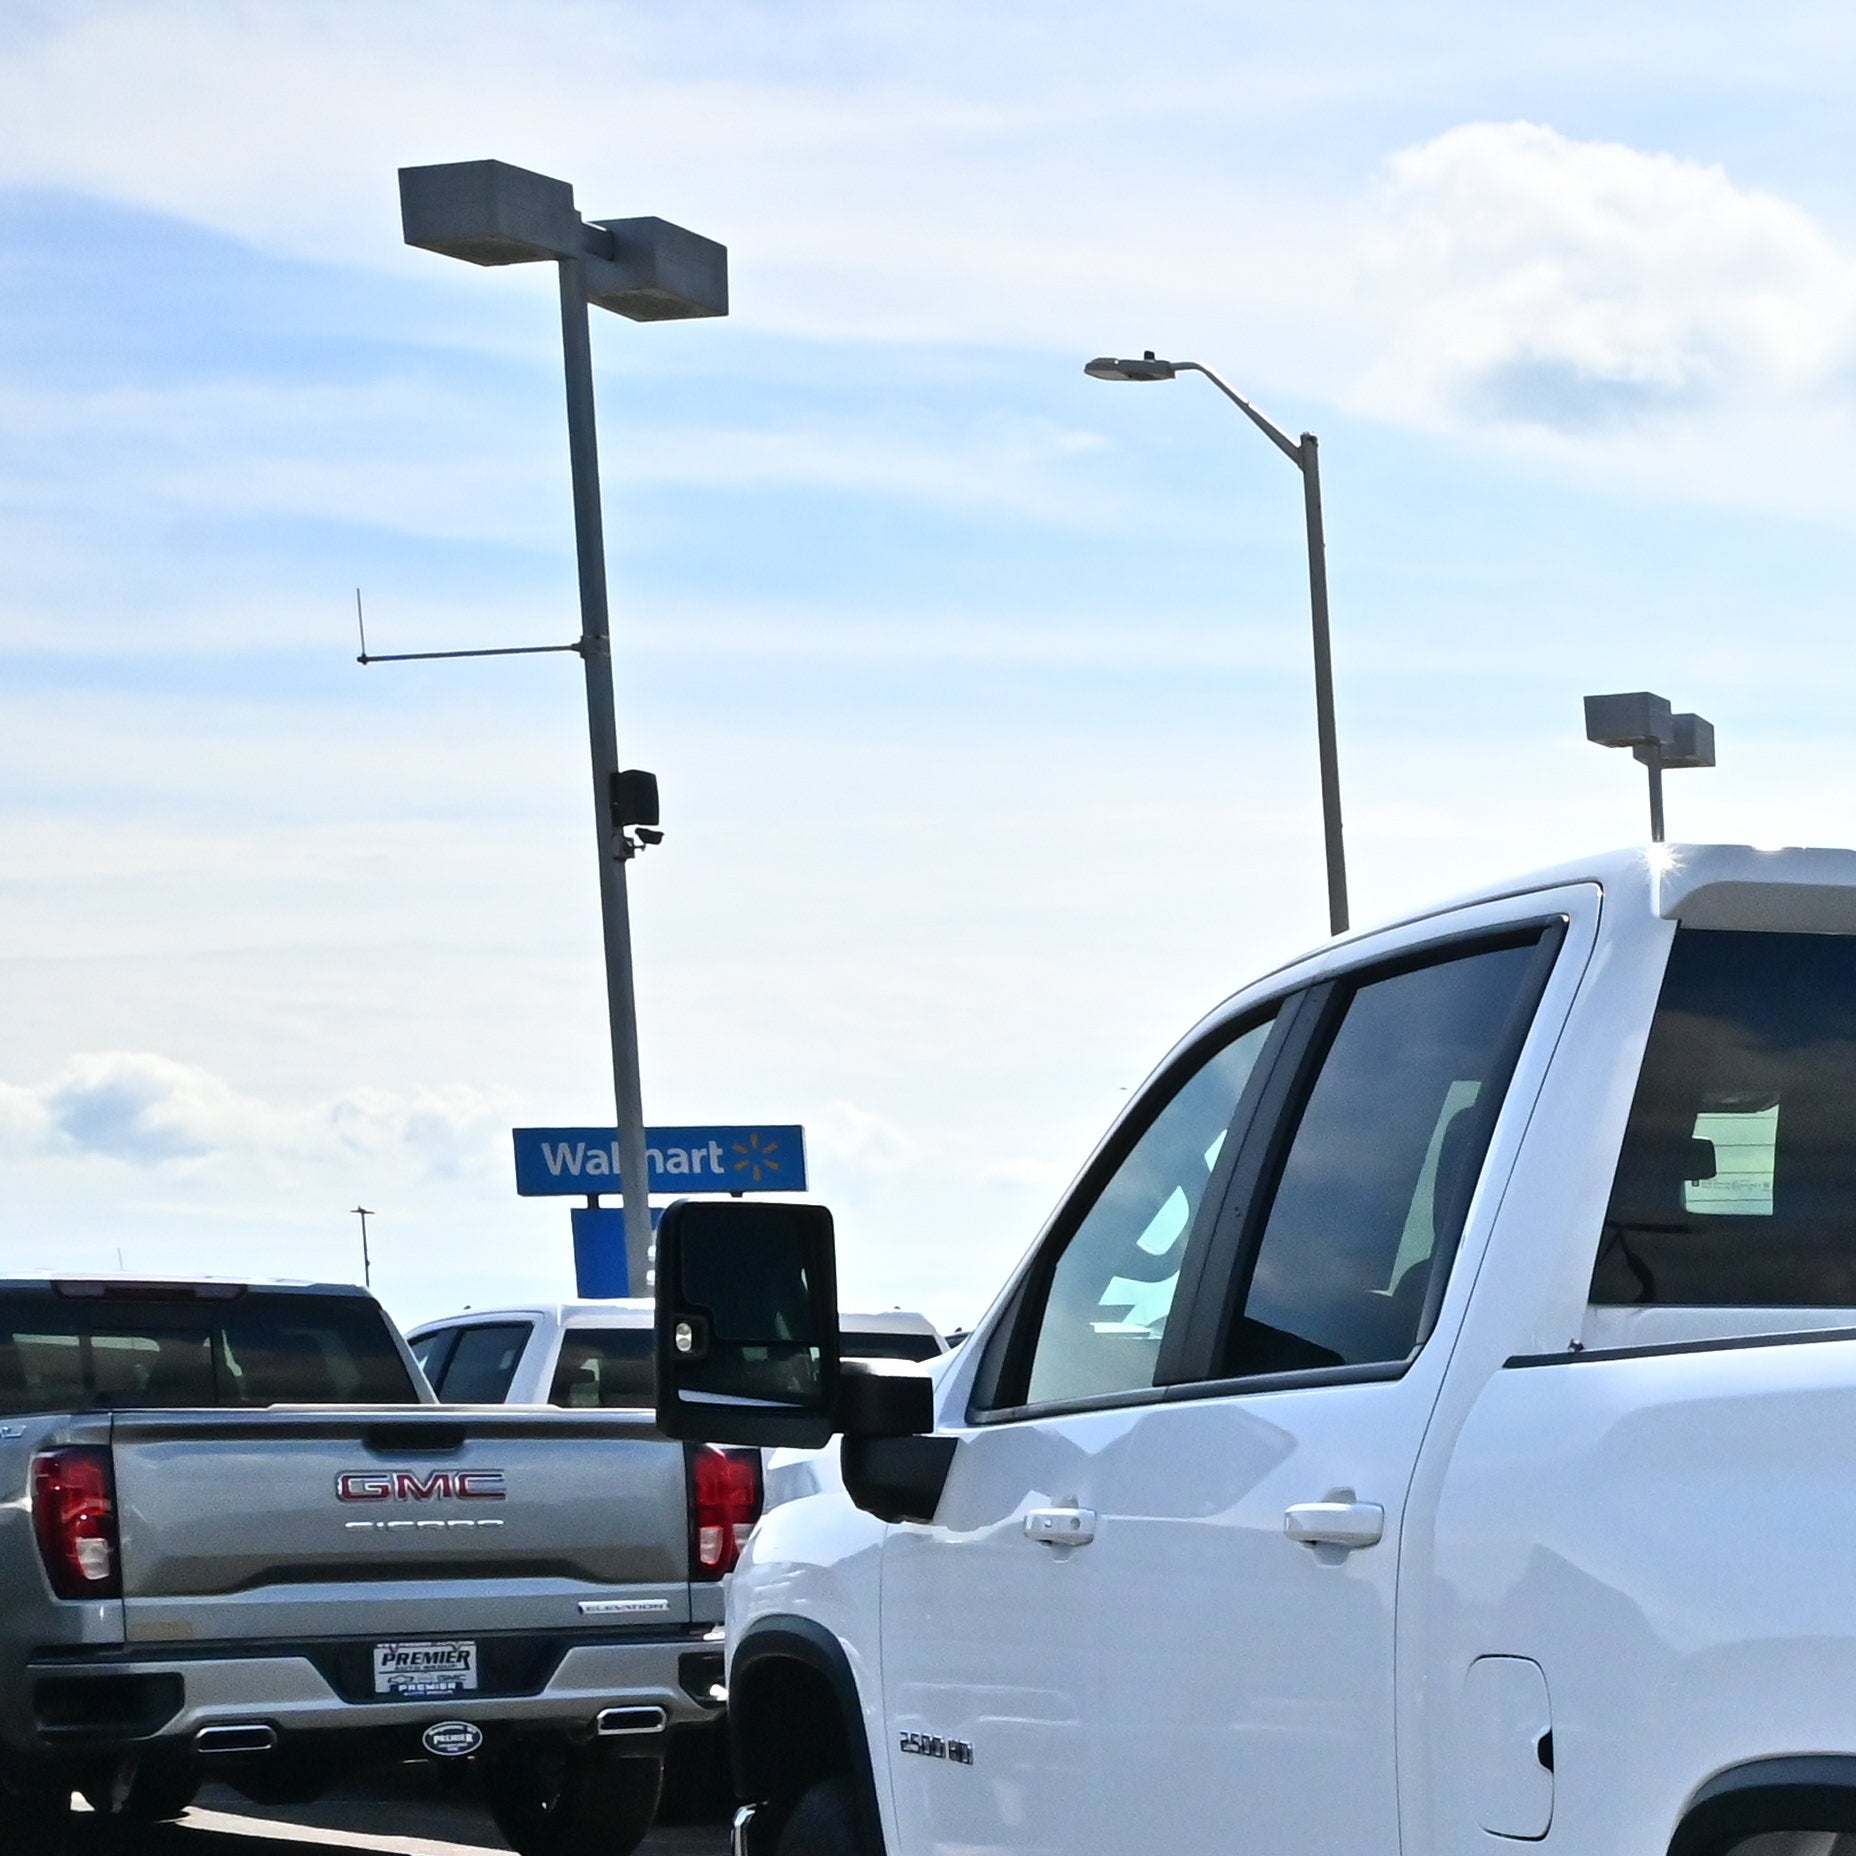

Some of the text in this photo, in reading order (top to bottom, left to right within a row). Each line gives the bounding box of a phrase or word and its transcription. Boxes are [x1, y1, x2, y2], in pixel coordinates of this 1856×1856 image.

[335, 1469, 506, 1502] GMC
[586, 1603, 664, 1612] ELEVATION
[381, 1650, 471, 1671] PREMIER
[899, 1730, 947, 1759] 2500
